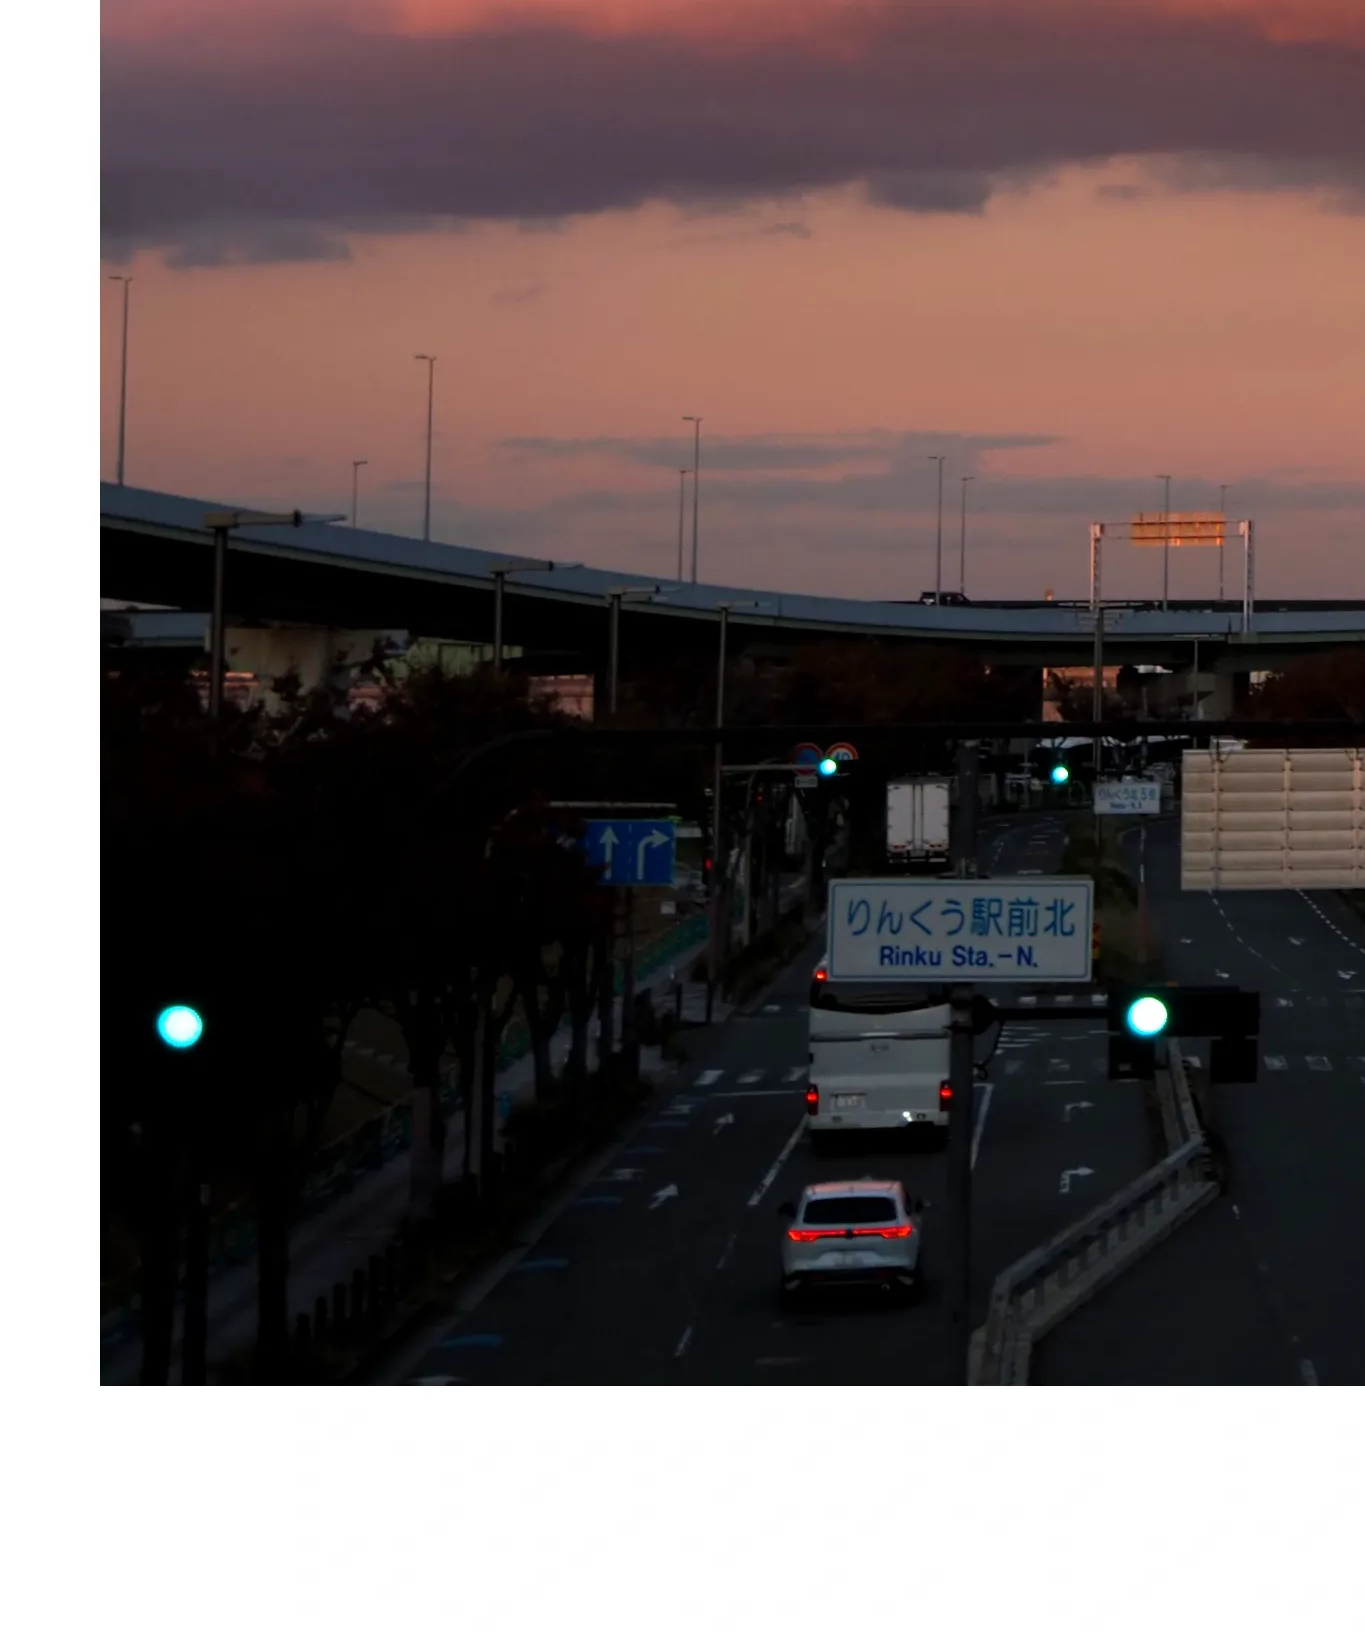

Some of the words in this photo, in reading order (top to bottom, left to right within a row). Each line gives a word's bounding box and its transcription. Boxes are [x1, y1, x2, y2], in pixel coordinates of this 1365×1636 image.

[847, 897, 1076, 937] りんくう駅前北
[880, 945, 941, 967] Rinku
